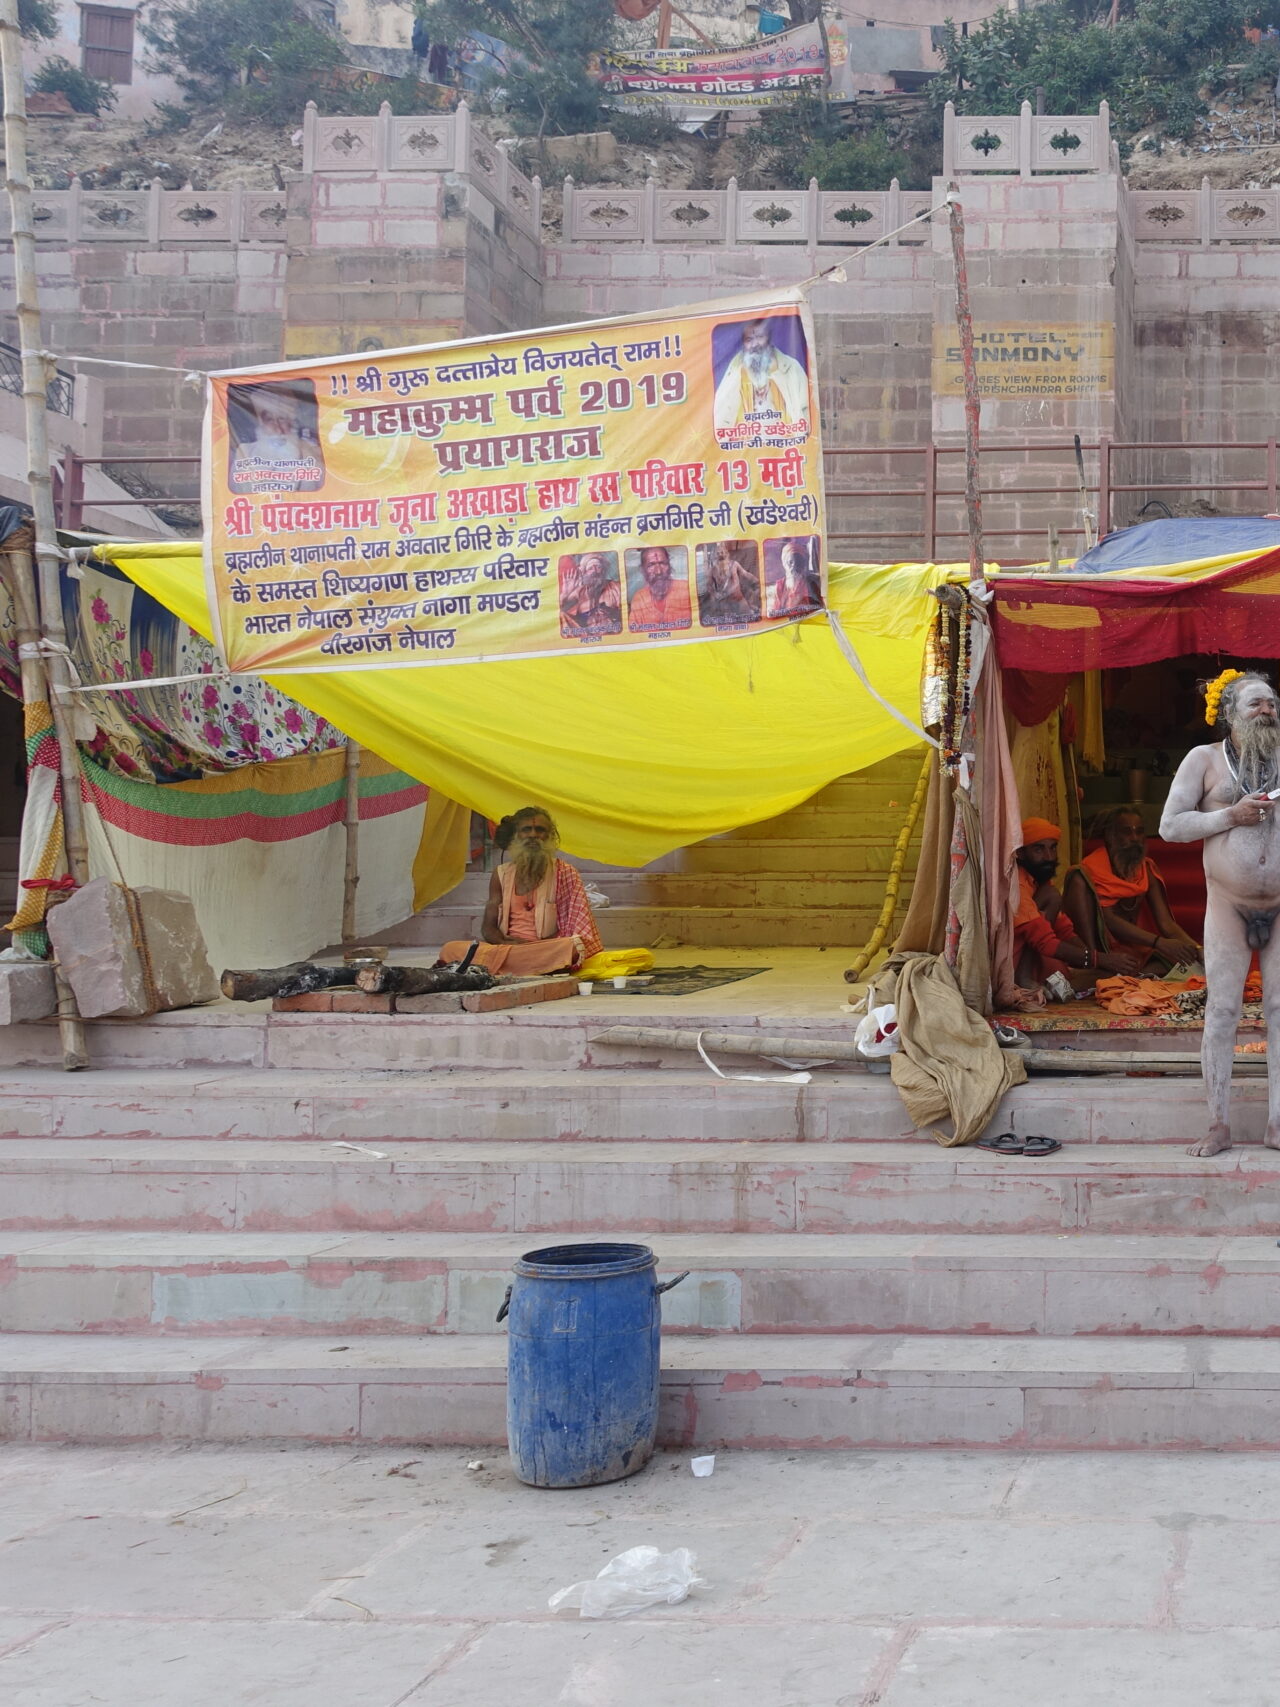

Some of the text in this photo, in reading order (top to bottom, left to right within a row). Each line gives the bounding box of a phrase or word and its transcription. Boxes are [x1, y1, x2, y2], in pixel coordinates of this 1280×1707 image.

[355, 366, 383, 393] श्री
[387, 367, 430, 397] गुरू
[434, 353, 518, 384] दत्तात्रेय
[523, 341, 624, 374] विजयतेत्
[1003, 375, 1032, 384] VIEW
[1036, 375, 1067, 384] FROM
[1069, 375, 1107, 384] ROOMS
[343, 371, 688, 440] महाकुम्भ पर्व 2019
[744, 409, 783, 422] ब्रह्मलीन
[716, 419, 808, 441] ब्रजगिरि खंडेश्वरी
[746, 437, 763, 449] जी
[765, 434, 807, 448] महाराज
[433, 425, 603, 475] प्रयागराज
[224, 448, 805, 536] श्री पंचदशनाम जूना अखाड़ा हाथ रस परिवार 13 मढ़ी
[235, 468, 321, 483] राम अवतार गिरि
[252, 482, 294, 492] महाराज
[225, 543, 286, 574] ब्रह्मलीन
[290, 536, 356, 564] थानापती
[361, 541, 391, 559] राम
[396, 536, 451, 558] अवतार
[454, 525, 493, 552] गिरि
[496, 525, 514, 548] के
[517, 516, 579, 549] ब्रह्मलीन
[636, 503, 704, 536] ब्रजगिरि
[708, 501, 732, 527] जी
[738, 494, 819, 531] (खंडेश्वरी)
[230, 553, 550, 604] के समस्त शिष्यगण हाथरस परिवार
[245, 590, 541, 634] भारत नेपाल संयुक्त नागा मण्डल
[320, 624, 457, 655] वीरगंज नेपाल
